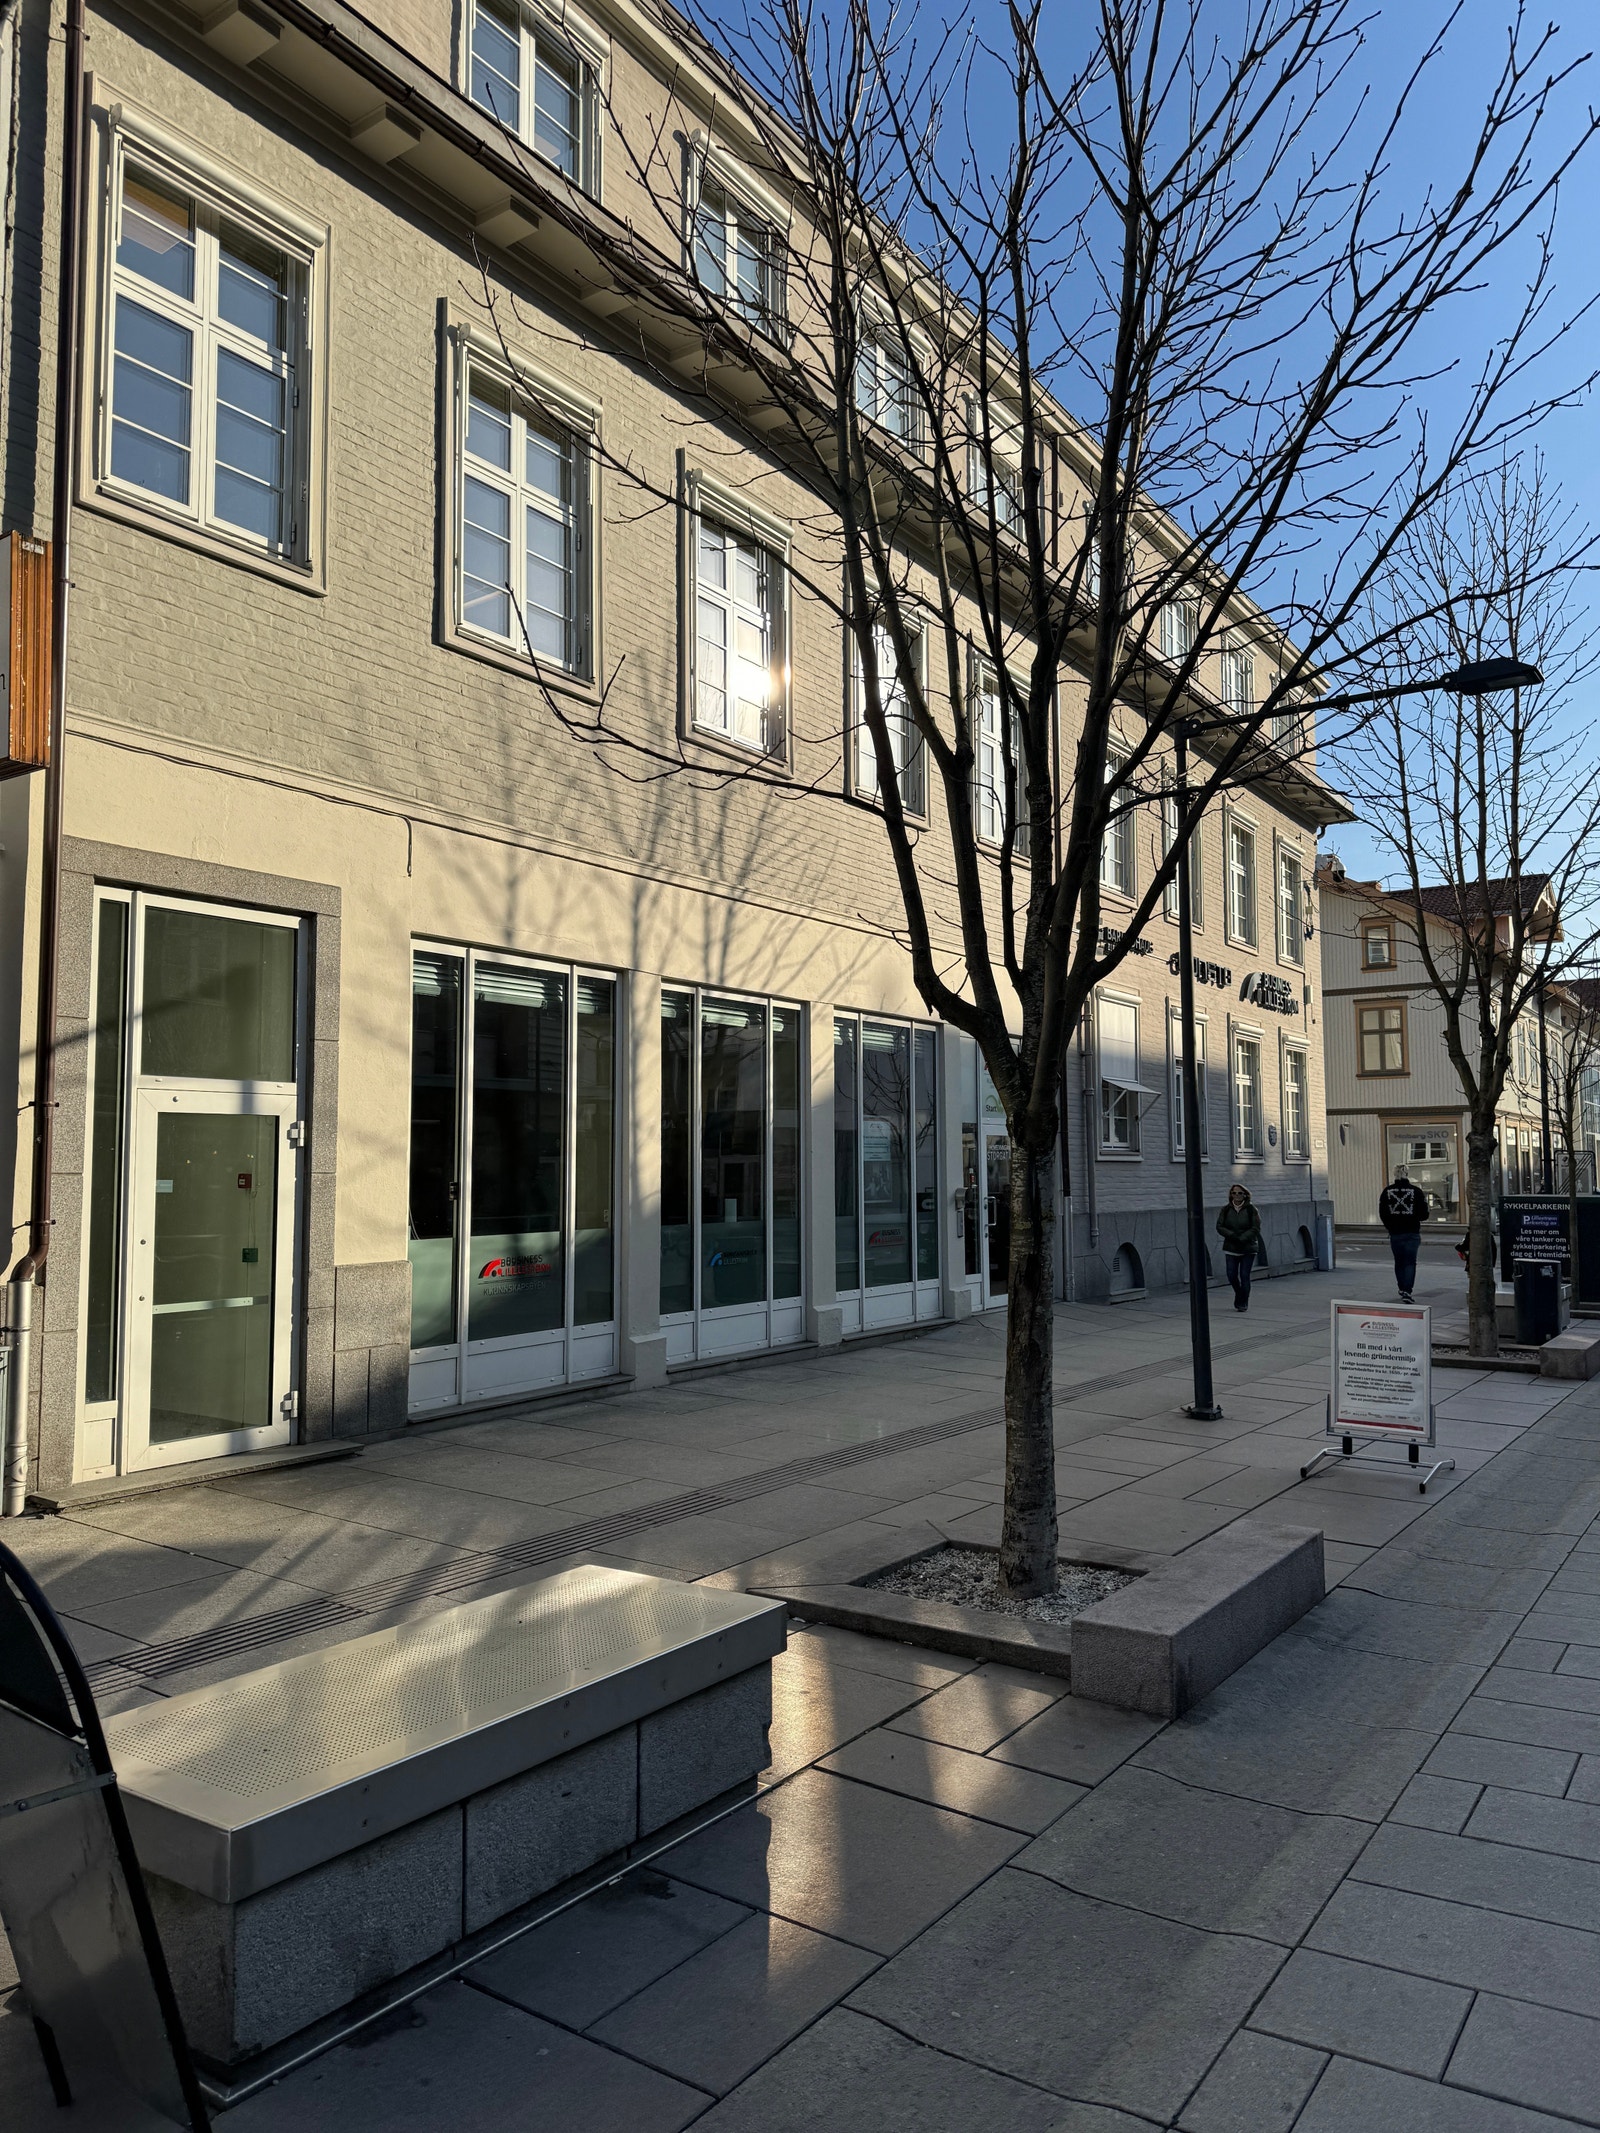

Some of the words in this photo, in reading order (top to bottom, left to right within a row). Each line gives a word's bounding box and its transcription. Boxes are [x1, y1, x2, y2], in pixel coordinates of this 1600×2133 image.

[1264, 973, 1292, 994] BUSINESS
[1427, 1130, 1449, 1139] SKO
[1513, 1243, 1567, 1252] sykkelparkering
[1357, 1342, 1366, 1350] Bli
[1368, 1343, 1383, 1351] med
[1388, 1345, 1402, 1353] vårt
[1344, 1350, 1370, 1359] levende
